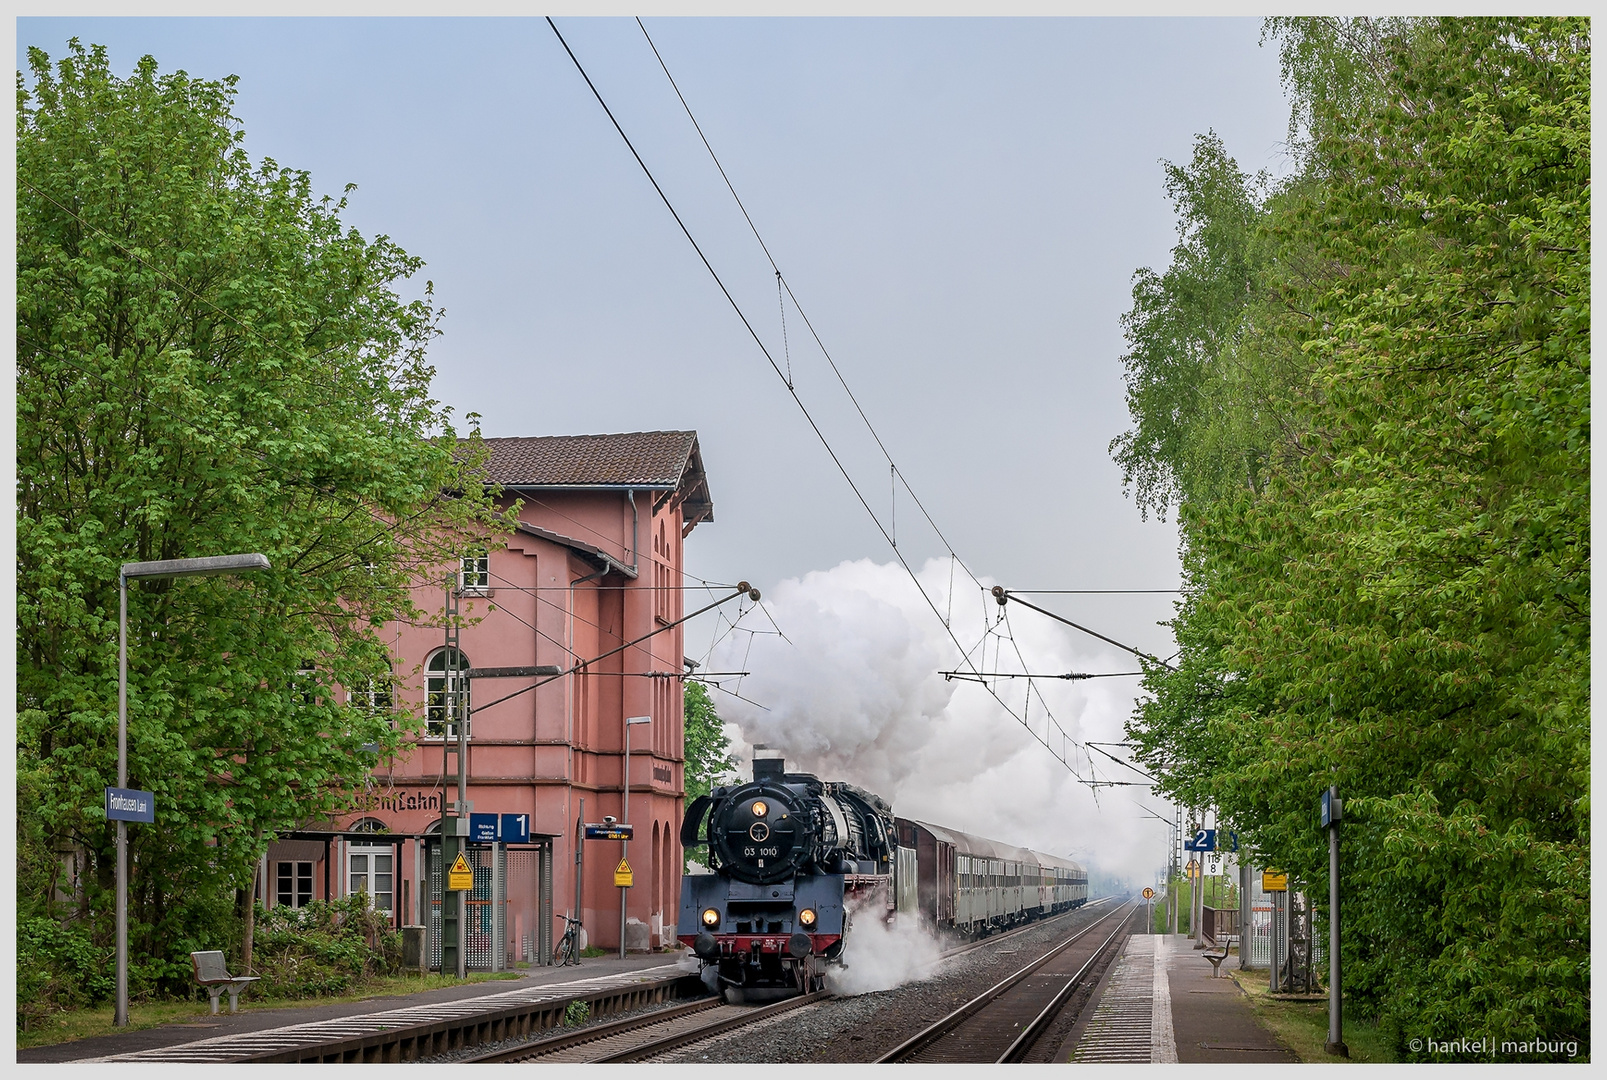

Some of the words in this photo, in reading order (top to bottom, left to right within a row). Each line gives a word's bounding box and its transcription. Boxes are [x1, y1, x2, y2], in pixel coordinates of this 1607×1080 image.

[110, 792, 137, 812] Fronhausen
[516, 814, 526, 837] 1
[1195, 830, 1208, 847] 2
[744, 847, 756, 857] 03
[760, 847, 777, 857] 1010
[1210, 864, 1217, 874] 8
